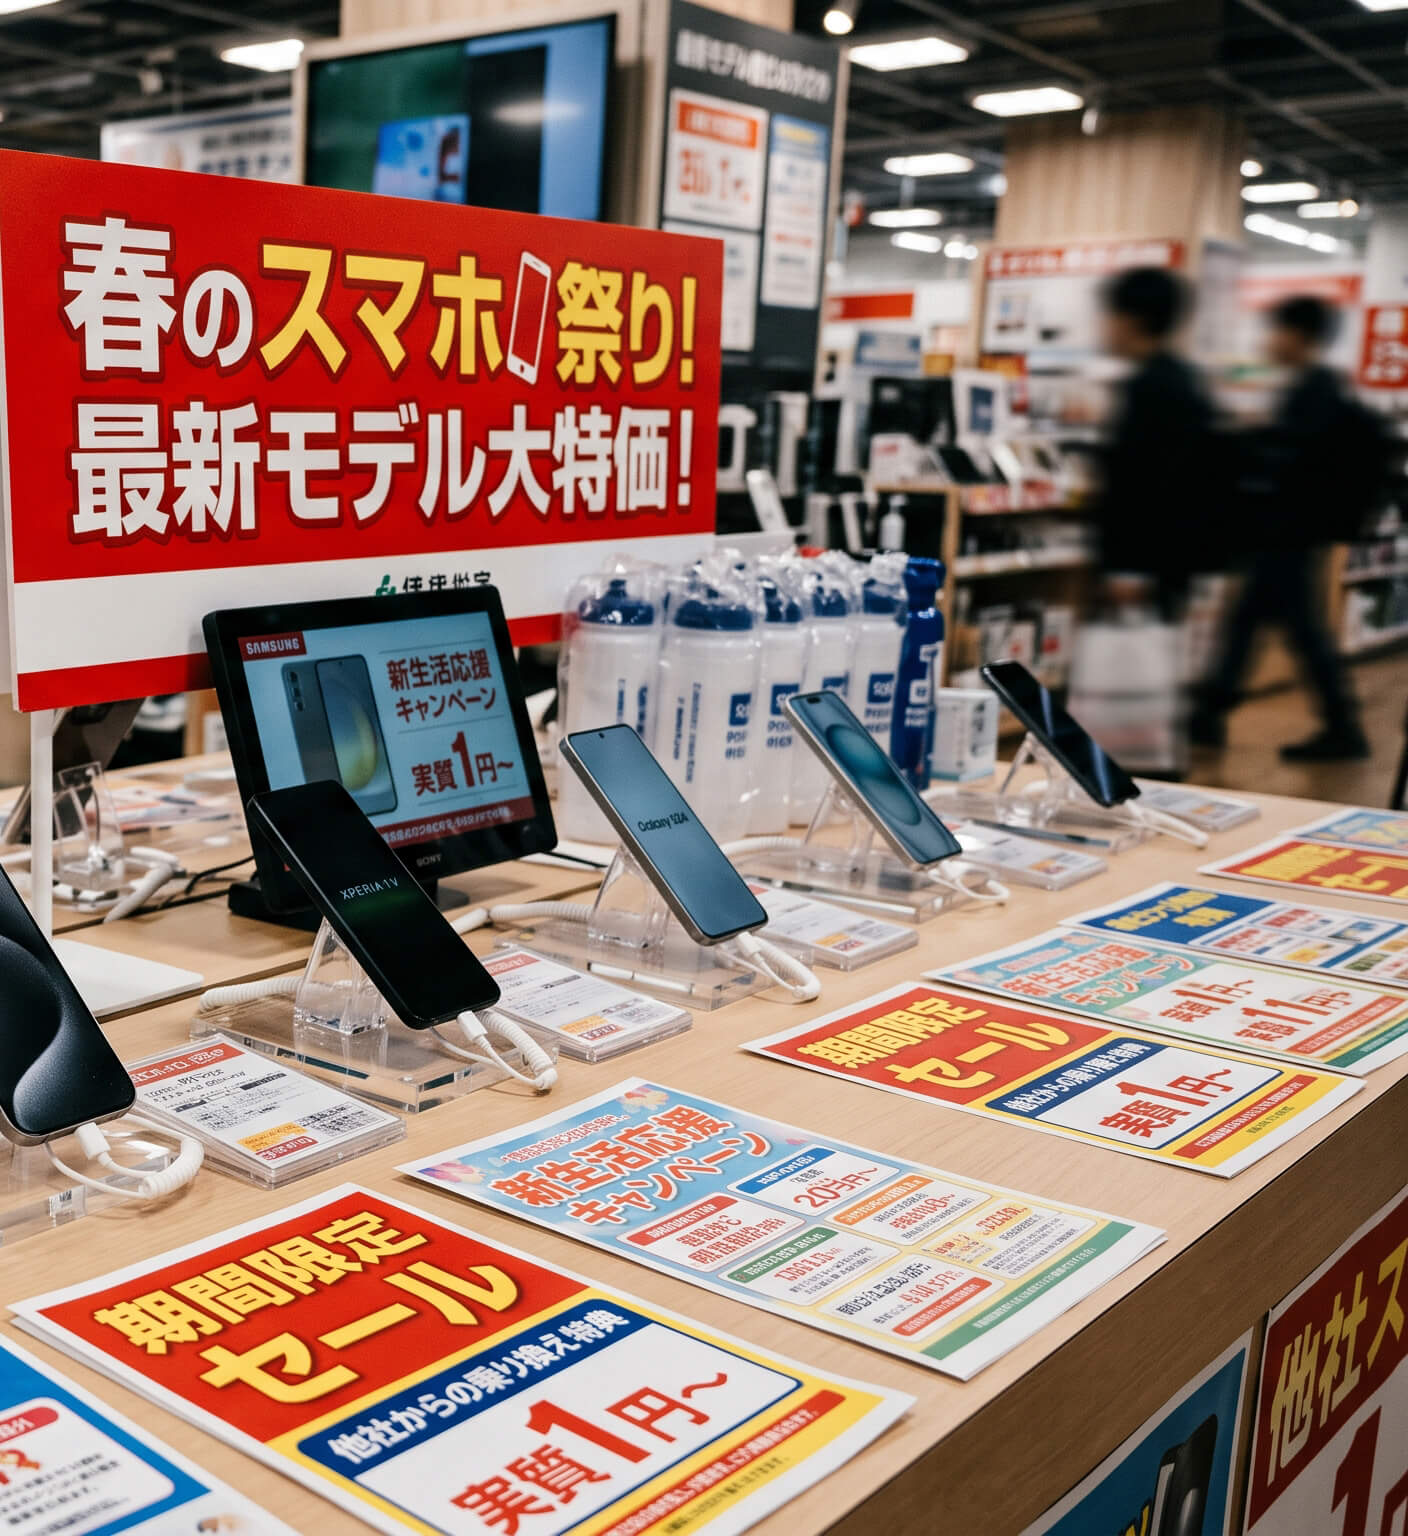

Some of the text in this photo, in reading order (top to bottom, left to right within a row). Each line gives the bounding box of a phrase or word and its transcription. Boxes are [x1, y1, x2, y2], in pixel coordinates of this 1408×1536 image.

[71, 401, 693, 538] 最新モデル大特価!
[246, 637, 300, 655] SAMSUNG
[386, 649, 492, 691] 新生活応援
[395, 687, 497, 723] キャンペーン
[339, 881, 384, 900] XPERIA
[416, 854, 442, 867] SONY
[796, 997, 988, 1069] 期間限定
[885, 1021, 1070, 1089] セール
[490, 1106, 734, 1206] 新生活応援
[567, 1131, 771, 1225] キャンペーン
[93, 1210, 429, 1355] 期間限定
[198, 1261, 519, 1404] セール
[328, 1309, 632, 1465] 他社からの乗り換え特典
